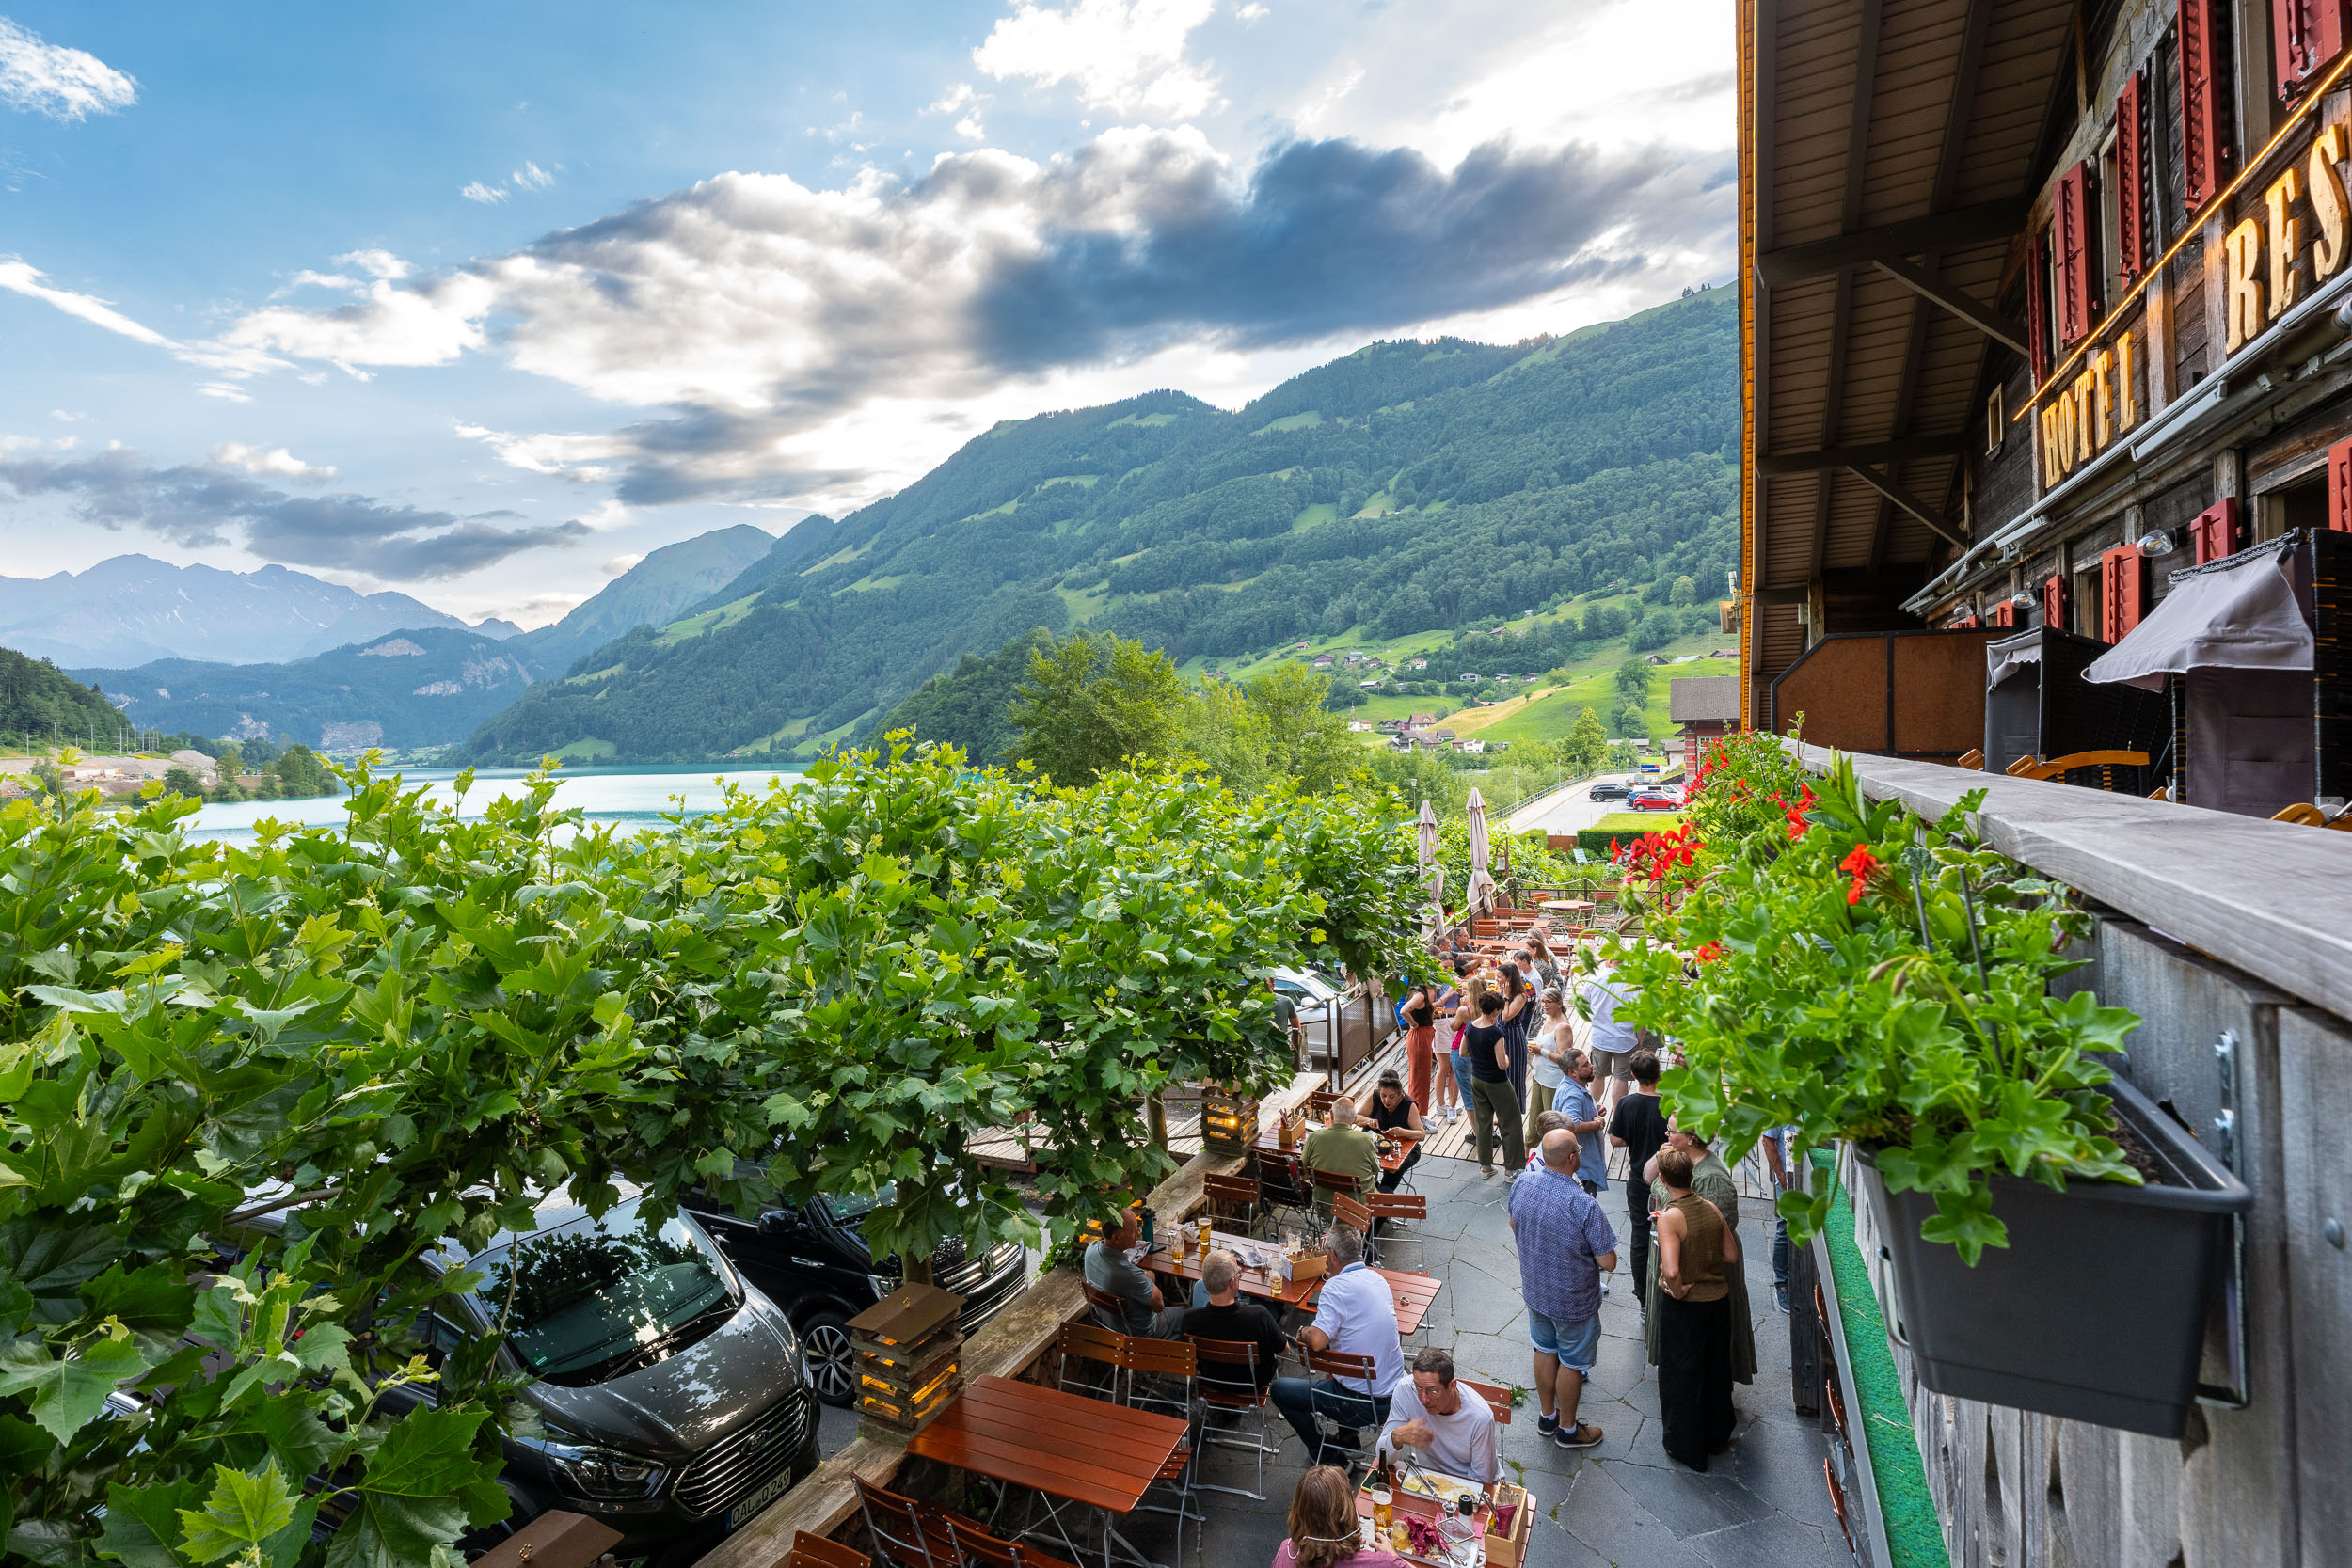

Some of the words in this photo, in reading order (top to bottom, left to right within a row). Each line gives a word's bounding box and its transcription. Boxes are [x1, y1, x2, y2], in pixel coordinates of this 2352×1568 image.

[2041, 331, 2138, 489] HOTEL
[2226, 123, 2351, 355] RES
[733, 1499, 755, 1524] OAL
[761, 1486, 769, 1502] Q
[771, 1470, 789, 1497] 249
